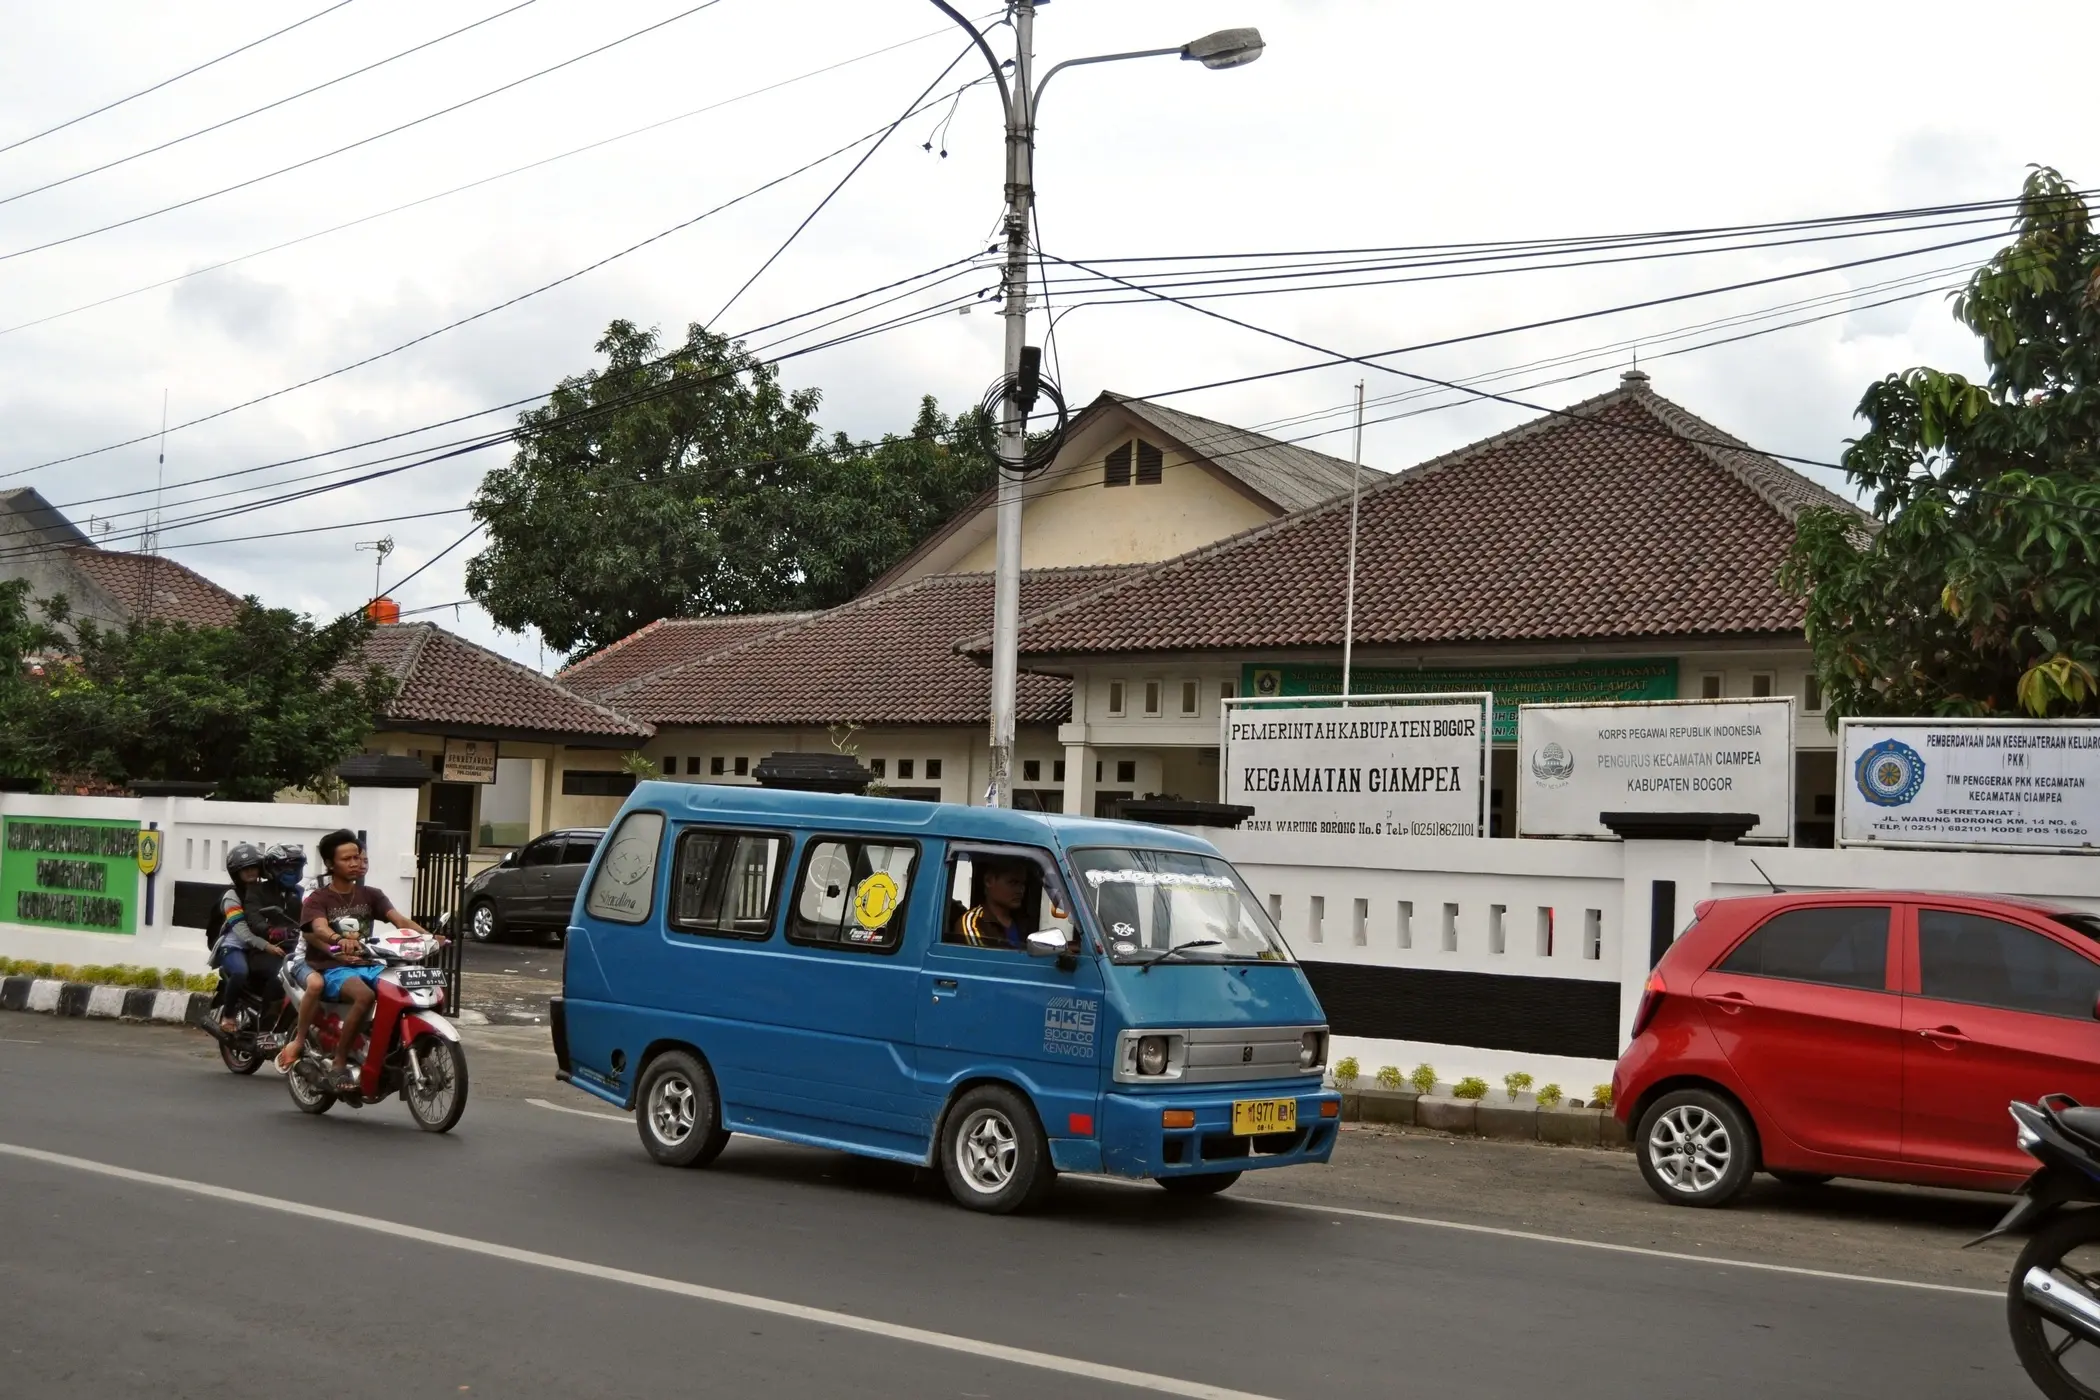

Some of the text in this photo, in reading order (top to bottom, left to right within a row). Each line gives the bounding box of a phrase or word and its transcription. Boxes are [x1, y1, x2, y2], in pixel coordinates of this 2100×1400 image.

[1557, 681, 1597, 691] PALING
[1600, 680, 1648, 690] LAMBAT
[1598, 725, 1762, 740] KORPS PEGAWAI REPUBLIK INDONESIA
[1926, 734, 1984, 748] PEMBERDAYAAN
[1986, 735, 2001, 748] DAN
[2003, 735, 2066, 749] KESEHJATERAAN
[1597, 751, 1762, 769] PENGURUS KECAMATAN CIAMPEA
[2007, 753, 2025, 767] PKK
[1627, 777, 1733, 792] KABUPATEN BOGOR
[1946, 774, 2085, 788] TIM PENGGERAK PKK KECAMATAN
[1968, 790, 2062, 803] KECAMATAN CIAMPEA
[1936, 808, 2014, 816] SEKRETARIAT
[1246, 820, 1273, 831] RAYA
[1276, 820, 1318, 833] WARUNG
[1320, 821, 1356, 834] BORONG
[407, 970, 427, 979] 4474
[1046, 1009, 1096, 1029] HKS
[1044, 1028, 1094, 1042] sparco
[1042, 1042, 1094, 1058] KENWOOD
[1235, 1104, 1242, 1122] F
[1251, 1102, 1275, 1123] 1977
